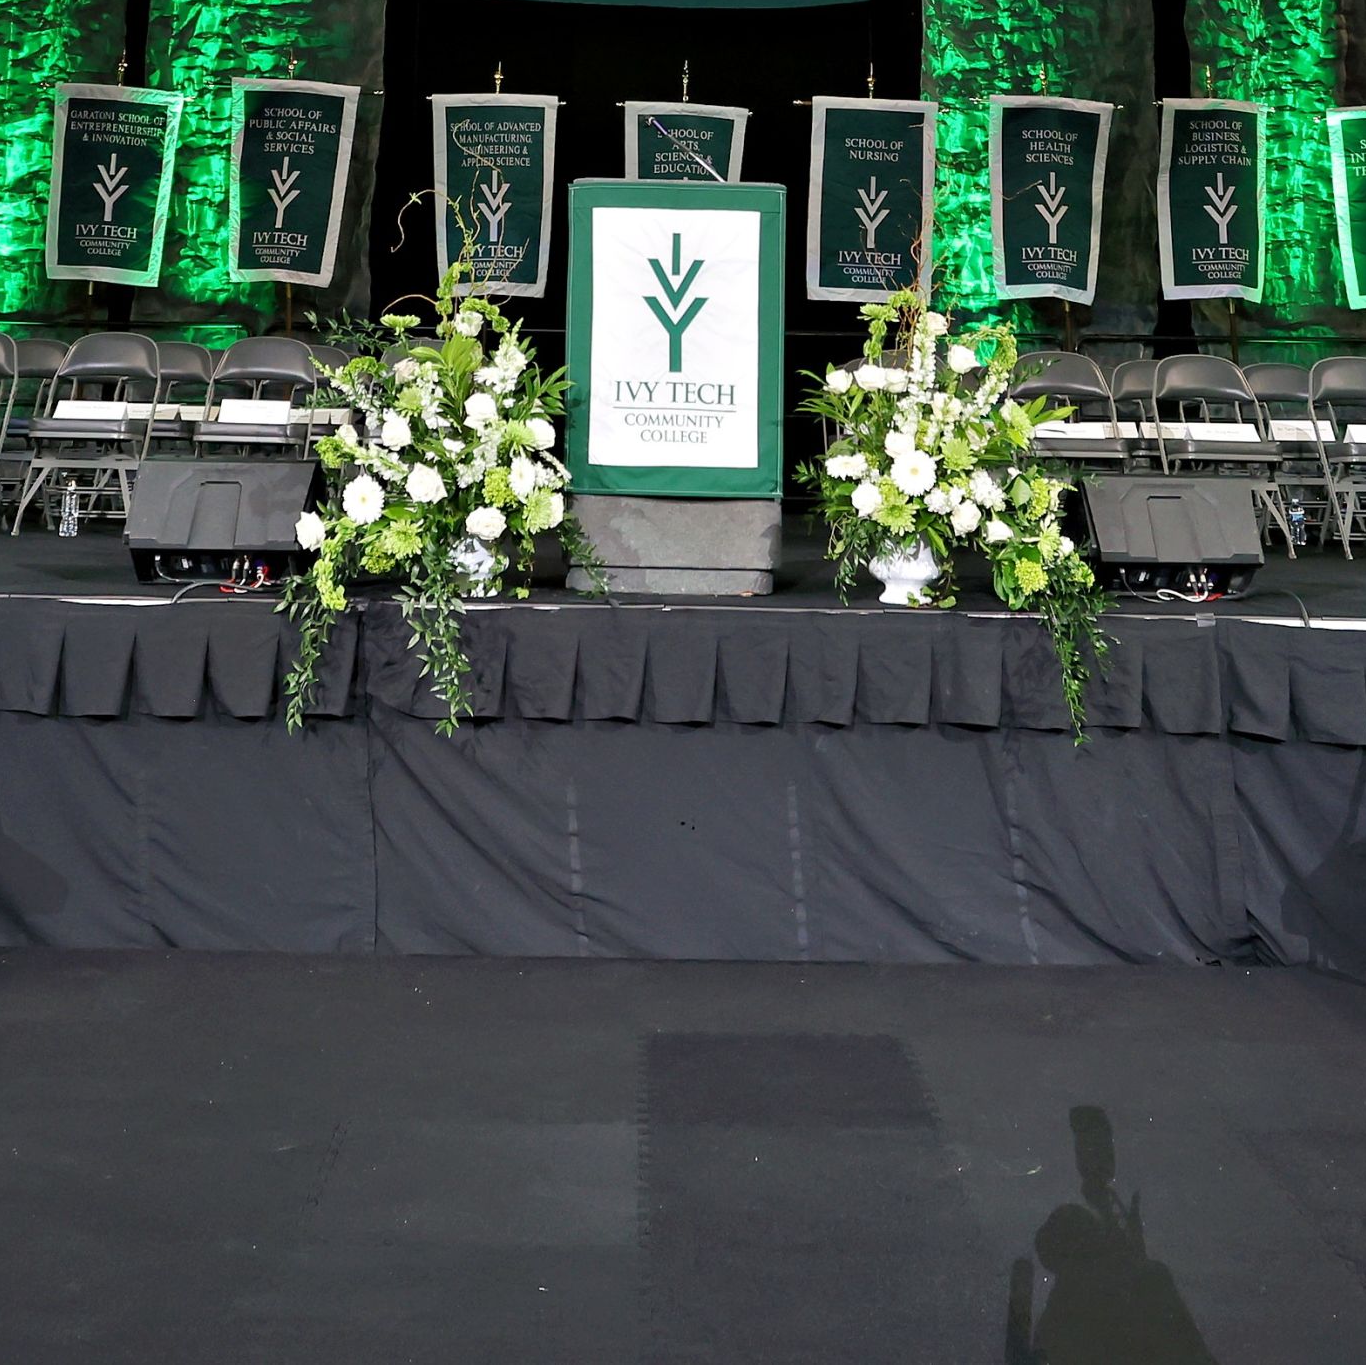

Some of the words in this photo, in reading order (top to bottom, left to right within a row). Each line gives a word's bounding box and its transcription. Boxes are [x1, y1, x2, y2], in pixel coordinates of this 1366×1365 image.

[117, 112, 151, 125] SCHOOL
[153, 116, 165, 126] OF
[264, 107, 306, 119] SCHOOL
[308, 110, 323, 120] OF
[70, 121, 163, 138] ENTREPRENEURSHIP
[249, 119, 286, 129] PUBLIC
[289, 121, 337, 134] AFFAIRS
[484, 122, 495, 132] OF
[497, 121, 542, 132] ADVANCED
[1189, 120, 1230, 130] SCHOOL
[1231, 120, 1243, 131] OF
[92, 133, 148, 146] INNOVATION
[275, 131, 315, 143] SOCIAL
[700, 130, 714, 141] OF
[1021, 129, 1064, 141] SCHOOL
[1065, 132, 1079, 142] OF
[263, 142, 315, 155] SERVICES
[522, 145, 529, 155] &
[844, 137, 888, 150] SCHOOL
[890, 140, 904, 151] OF
[1029, 141, 1071, 154] HEALTH
[1185, 143, 1239, 154] LOGISTICS
[1240, 145, 1247, 154] &
[461, 156, 495, 168] APPLIED
[496, 156, 531, 167] SCIENCE
[849, 150, 899, 162] NURSING
[1025, 153, 1074, 166] SCIENCES
[1178, 155, 1218, 166] SUPPLY
[1221, 155, 1252, 167] CHAIN
[653, 163, 711, 176] EDUCATIO
[75, 224, 99, 236] IVY
[101, 224, 138, 239] TECH
[79, 239, 131, 250] COMMUNITY
[252, 231, 272, 244] IVY
[273, 232, 309, 247] TECH
[87, 247, 122, 256] COLLEGE
[254, 247, 301, 258] COMMUNITY
[488, 245, 523, 258] TECH
[838, 250, 863, 263] IVY
[865, 251, 902, 266] TECH
[1021, 246, 1046, 260] IVY
[1047, 246, 1078, 262] TECH
[1192, 247, 1216, 261] IVY
[1218, 247, 1250, 261] TECH
[260, 255, 291, 265] COLLEGE
[1027, 263, 1072, 274] COMMUNITY
[1198, 263, 1246, 273] COMMUNITY
[1207, 271, 1242, 280] COLLEGE
[614, 380, 659, 403] IVY
[665, 381, 736, 406] TECH
[624, 412, 725, 429] COMMUNITY
[640, 429, 708, 444] COLLEGE
